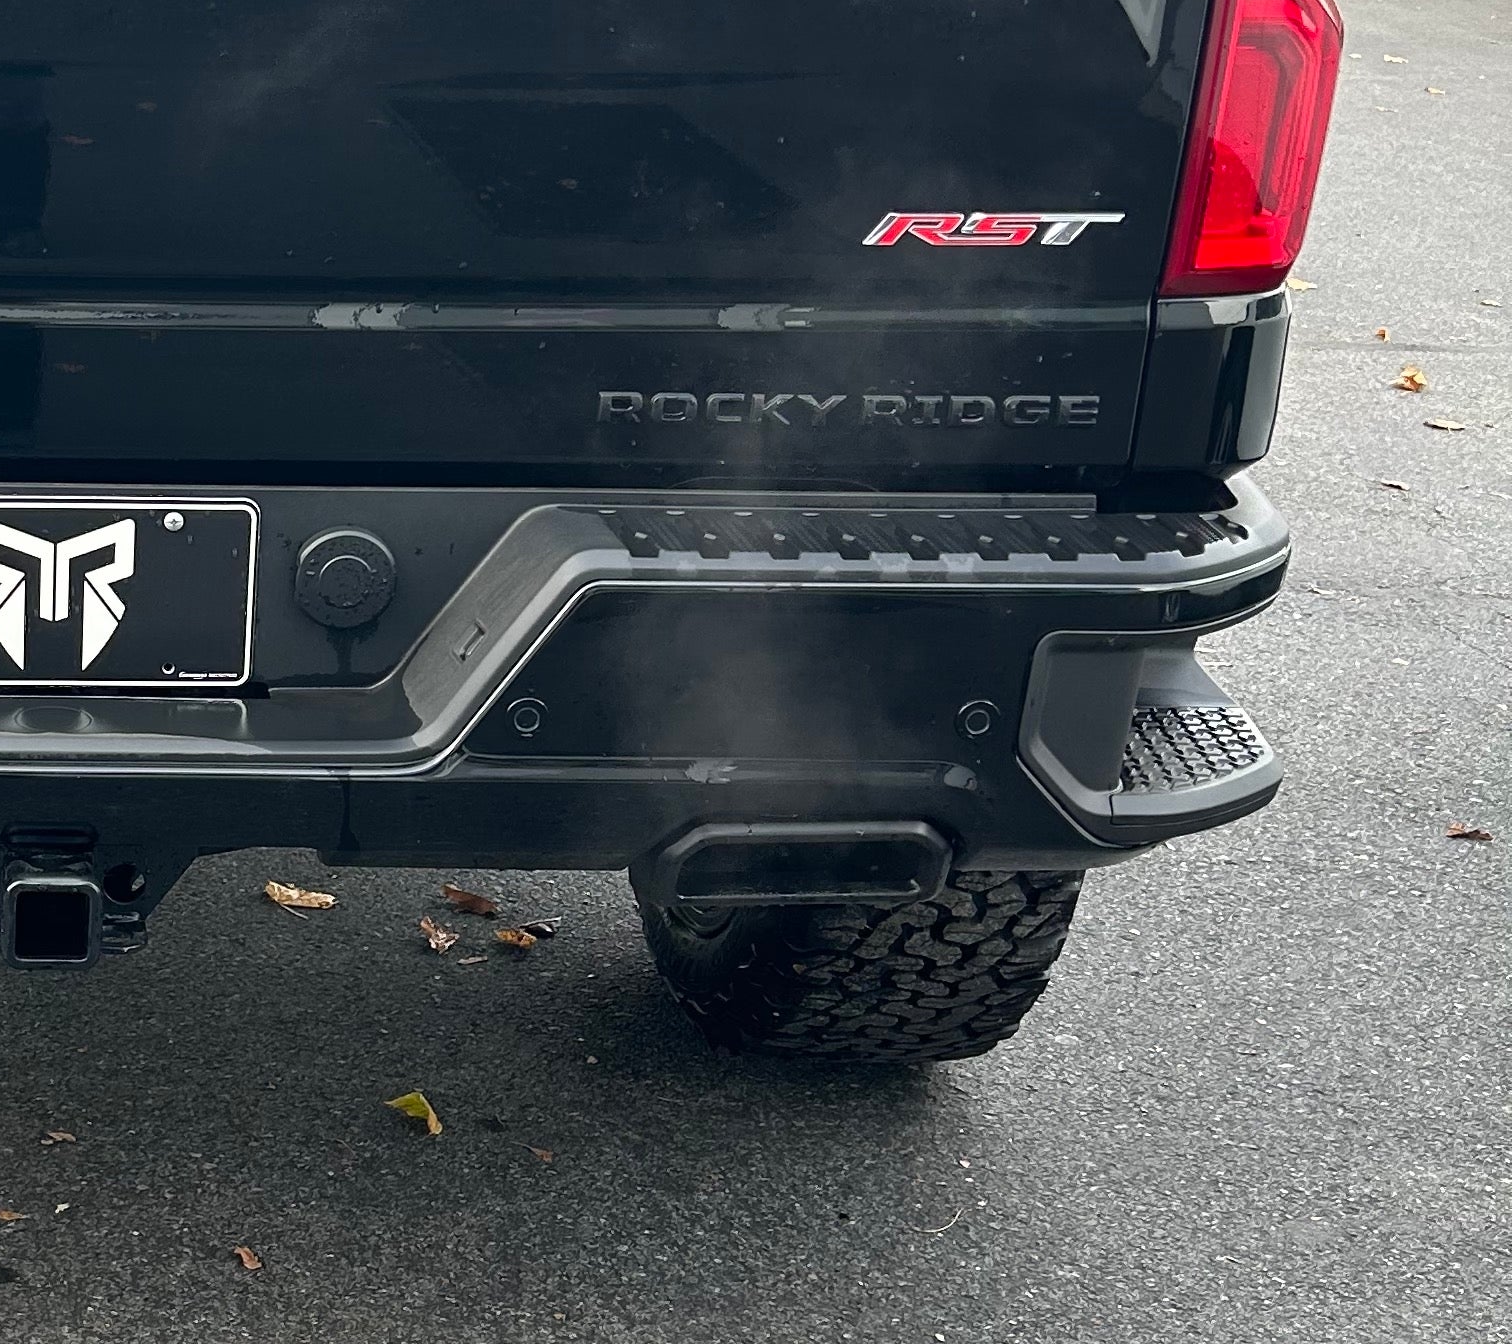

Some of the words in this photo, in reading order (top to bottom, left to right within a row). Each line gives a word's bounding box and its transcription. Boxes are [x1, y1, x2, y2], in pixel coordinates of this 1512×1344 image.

[862, 212, 1126, 245] RST
[595, 390, 847, 424] ROCKY
[862, 394, 1100, 427] RIDGE
